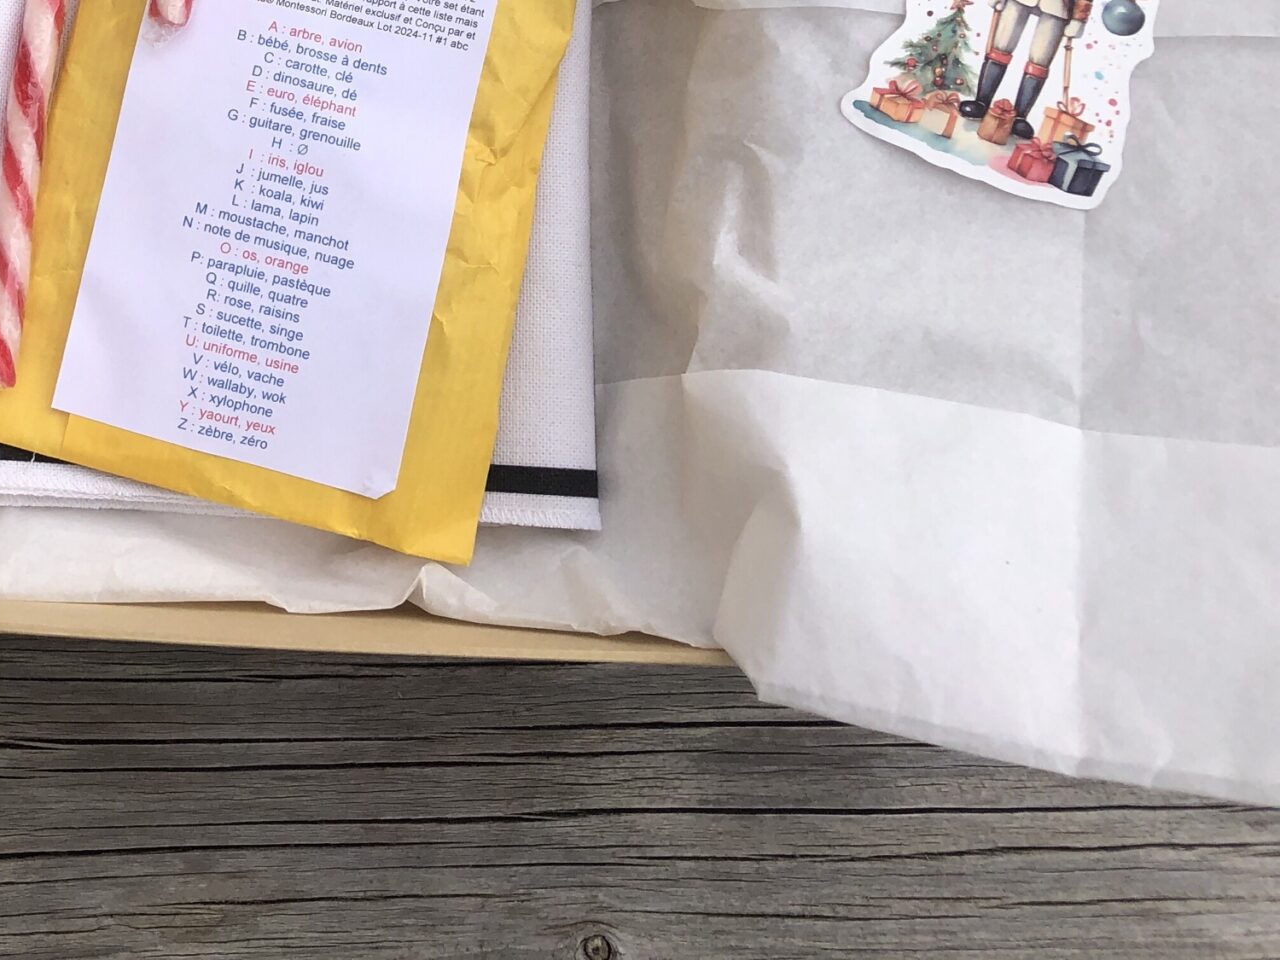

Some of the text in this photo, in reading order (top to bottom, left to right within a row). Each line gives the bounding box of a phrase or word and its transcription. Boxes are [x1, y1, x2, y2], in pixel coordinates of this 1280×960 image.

[364, 7, 402, 21] exclusif
[414, 17, 445, 33] Conçu
[446, 27, 464, 37] par
[407, 5, 431, 17] cette
[432, 9, 453, 22] liste
[454, 16, 478, 28] mais
[442, 1, 458, 11] set
[459, 3, 484, 17] étant
[267, 20, 362, 53] A arbre, avion
[329, 9, 374, 28] Bordeaux
[376, 20, 392, 32] Lot
[393, 25, 433, 42] 2024-11
[434, 35, 447, 45] #1
[449, 39, 468, 51] abc
[236, 28, 387, 75] B bébé, brosse à dents
[263, 51, 353, 83] C carotte, clé
[251, 64, 357, 101] D dinosaure, dé
[266, 87, 356, 117] euro, éléphant
[269, 101, 346, 130] fusée, fraise
[227, 108, 361, 151] G guitare, grenouille
[271, 136, 282, 149] H
[267, 152, 324, 177] iris, iglou
[256, 167, 329, 195] jumelle, jus
[250, 198, 319, 226] lama, lapin
[258, 183, 324, 211] koala, kiwi
[194, 201, 349, 251] M moustache, manchot
[182, 215, 354, 270] N note de musique, nuage
[219, 241, 309, 275] O os, orange
[205, 271, 308, 308] Q quille, quatre
[206, 257, 331, 297] parapluie, pastèque
[223, 295, 300, 323] rose, raisins
[201, 321, 310, 360] toilette, trombone
[215, 310, 303, 342] sucette, singe
[202, 341, 299, 374] uniforme, usine
[182, 366, 286, 404] W wallaby, wok
[213, 360, 284, 387] vélo, vache
[208, 393, 273, 417] xylophone
[197, 424, 268, 449] zèbre, zéro
[198, 408, 276, 435] yaourt, yeux
